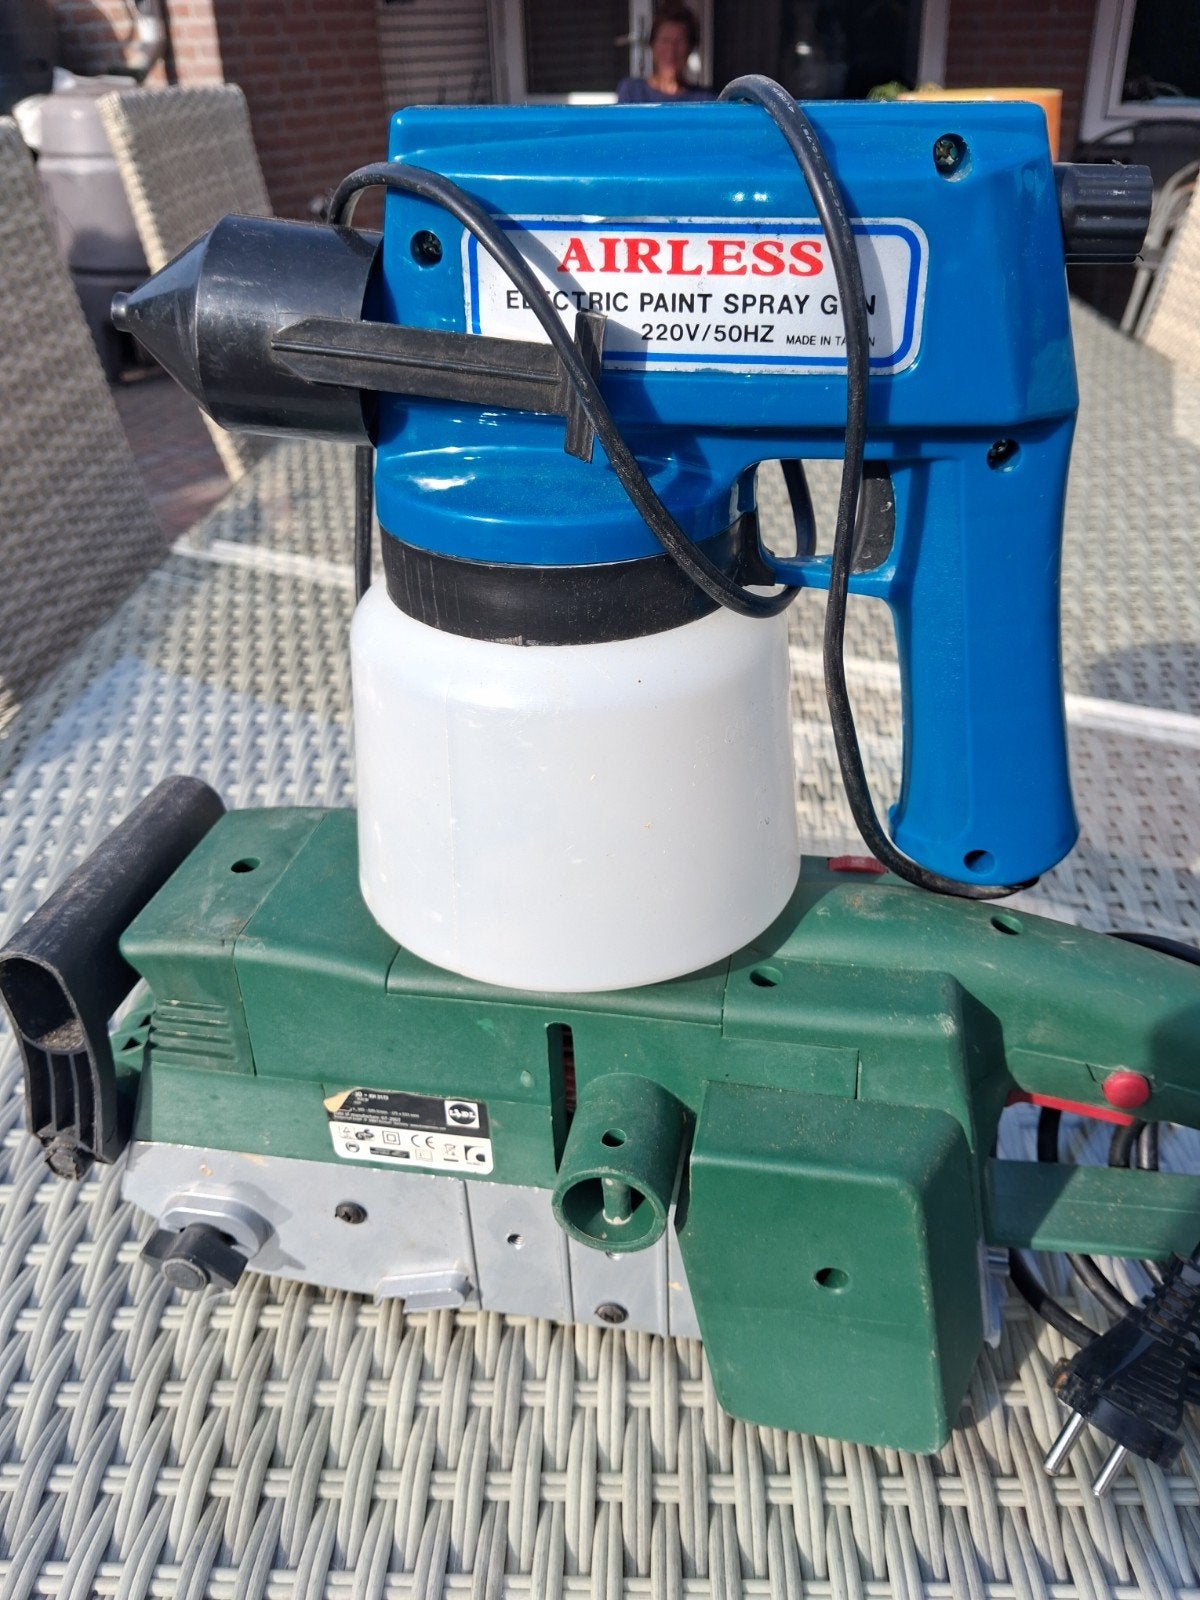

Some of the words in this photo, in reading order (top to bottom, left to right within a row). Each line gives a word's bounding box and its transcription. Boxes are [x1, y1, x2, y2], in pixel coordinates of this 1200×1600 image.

[557, 238, 824, 276] AIRLESS
[506, 289, 629, 312] ELCTRIC
[640, 292, 712, 313] PAINT
[723, 294, 810, 315] SPRAY
[820, 294, 876, 316] GN
[641, 323, 775, 343] 220V/50HZ
[786, 335, 816, 346] MADE
[820, 336, 832, 346] IN
[835, 336, 876, 347] TAN
